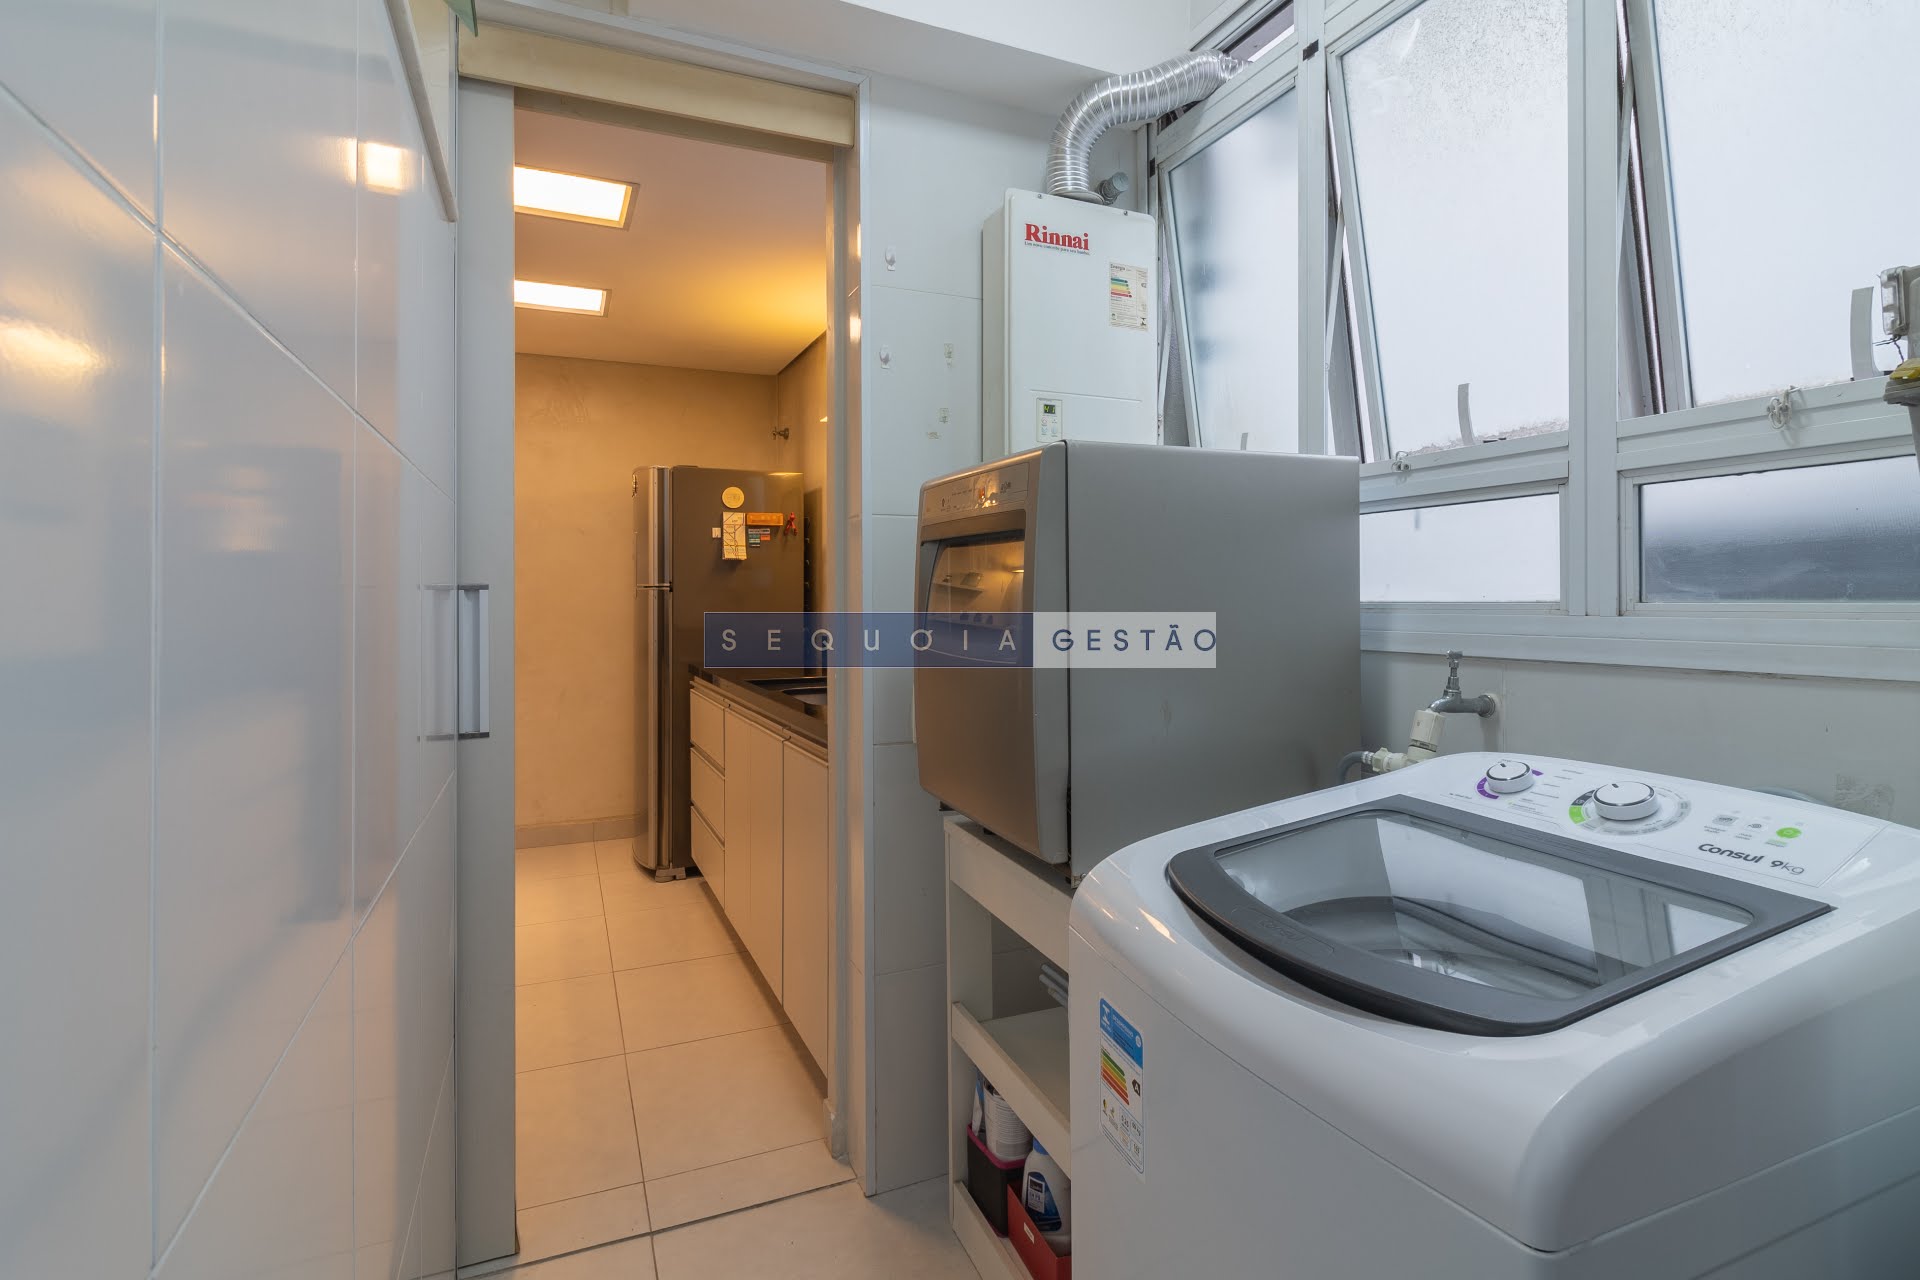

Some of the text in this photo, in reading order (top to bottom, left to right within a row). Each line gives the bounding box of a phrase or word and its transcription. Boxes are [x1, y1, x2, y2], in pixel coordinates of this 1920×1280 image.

[1025, 223, 1090, 251] Rinnai
[1698, 843, 1765, 863] Consul
[1770, 860, 1805, 876] 9kg
